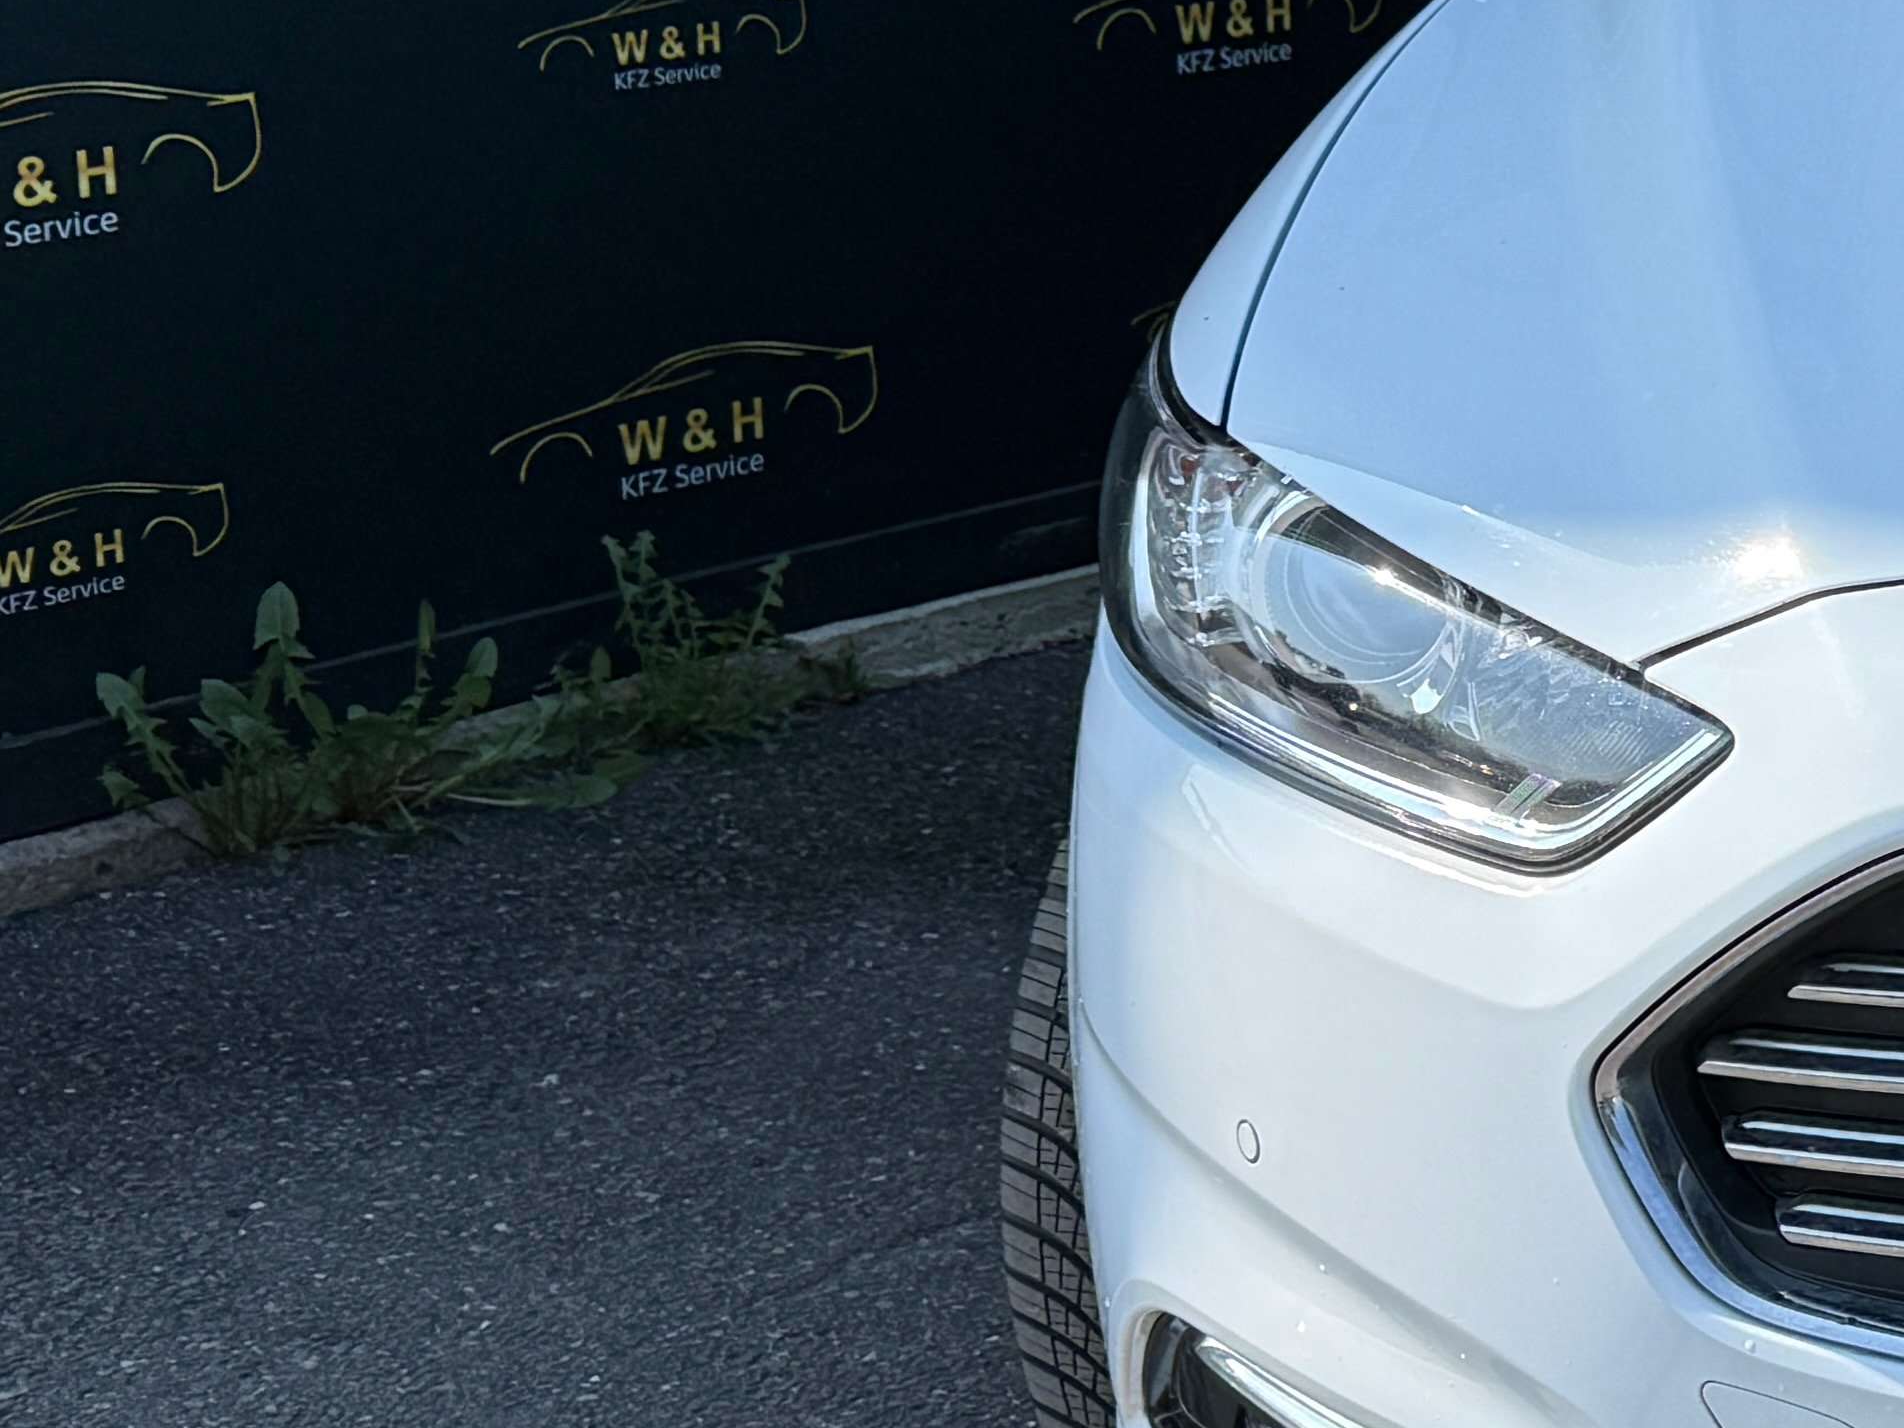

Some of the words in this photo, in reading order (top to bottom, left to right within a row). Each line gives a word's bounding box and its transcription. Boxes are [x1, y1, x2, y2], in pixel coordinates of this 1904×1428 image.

[612, 29, 649, 66] W
[659, 26, 686, 60] &
[696, 21, 721, 56] H
[1175, 1, 1215, 44] W
[614, 68, 650, 90] KFZ
[654, 63, 722, 86] Service
[1176, 48, 1215, 75] KFZ
[1219, 43, 1292, 69] Service
[13, 155, 57, 207] &
[76, 145, 117, 199] H
[3, 211, 119, 247] Service
[618, 415, 667, 468] W
[682, 408, 717, 453] &
[732, 396, 764, 443] H
[621, 468, 668, 500] KFZ
[674, 453, 765, 488] Service
[49, 539, 81, 577] &
[94, 528, 124, 568] H
[43, 575, 125, 606] Service
